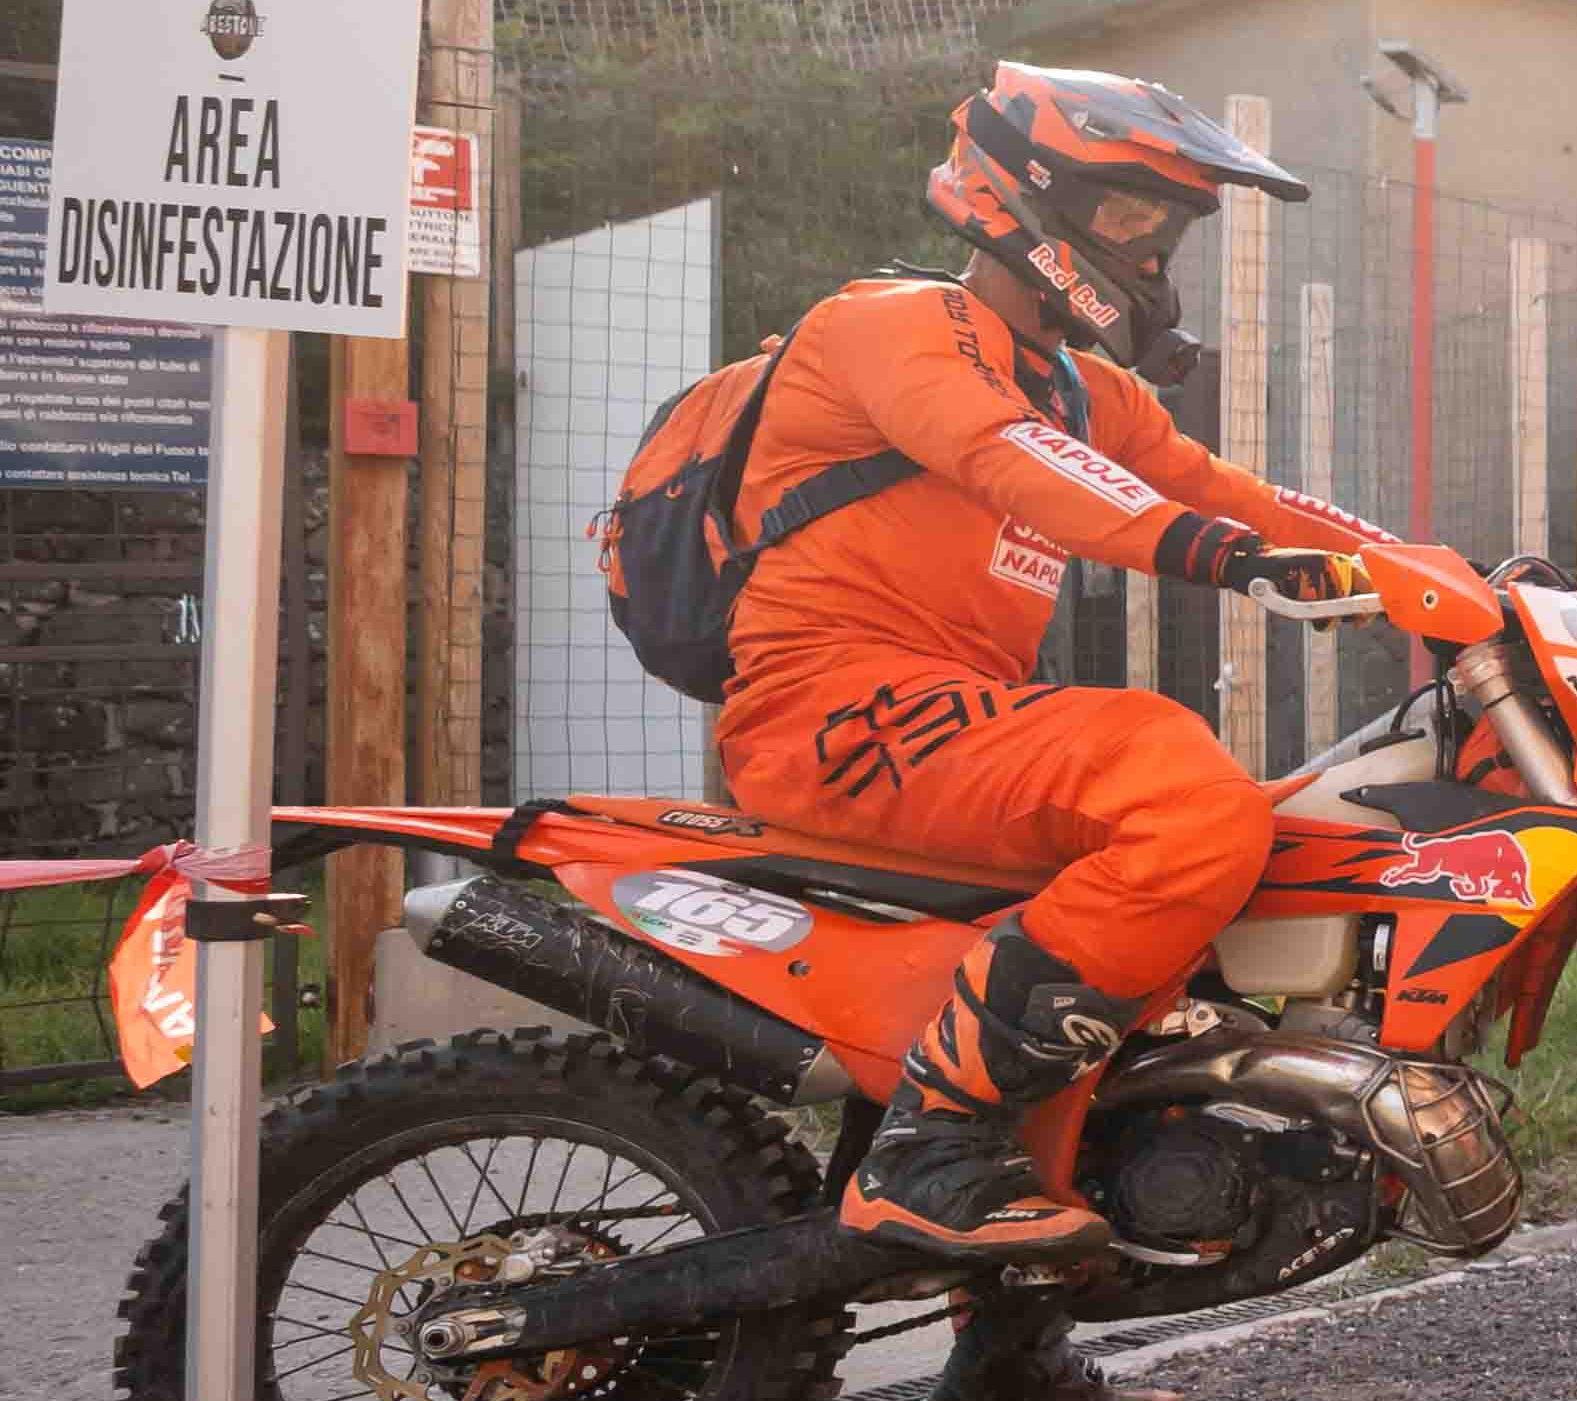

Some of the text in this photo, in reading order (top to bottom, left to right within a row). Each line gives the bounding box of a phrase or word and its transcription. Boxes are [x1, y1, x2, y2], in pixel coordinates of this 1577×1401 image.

[164, 94, 281, 190] AREA
[57, 196, 387, 308] DISINFESTAZIONE
[1028, 242, 1120, 327] Red Bull
[633, 878, 796, 943] 165
